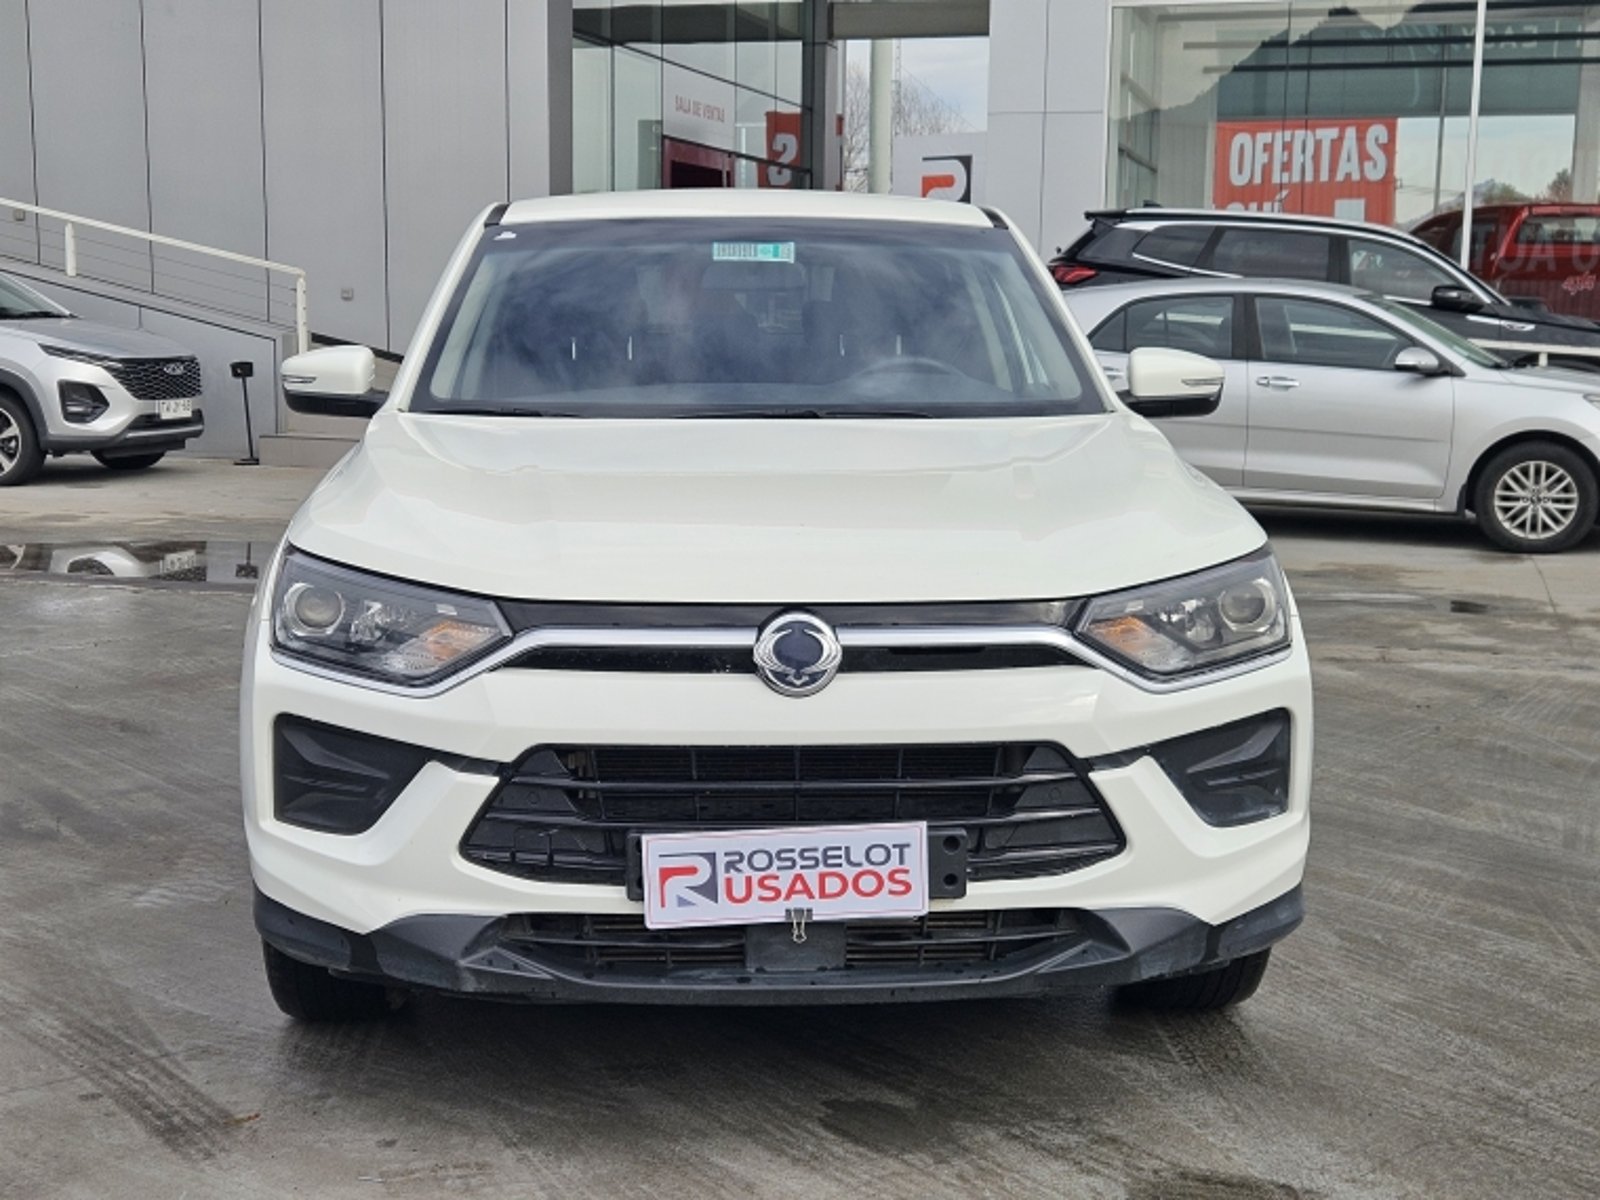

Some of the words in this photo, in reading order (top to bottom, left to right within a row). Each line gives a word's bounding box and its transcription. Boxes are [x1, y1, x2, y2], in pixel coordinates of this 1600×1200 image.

[1228, 123, 1388, 188] OFERTAS
[723, 843, 911, 874] ROSSELOT
[724, 868, 913, 905] USADOS
